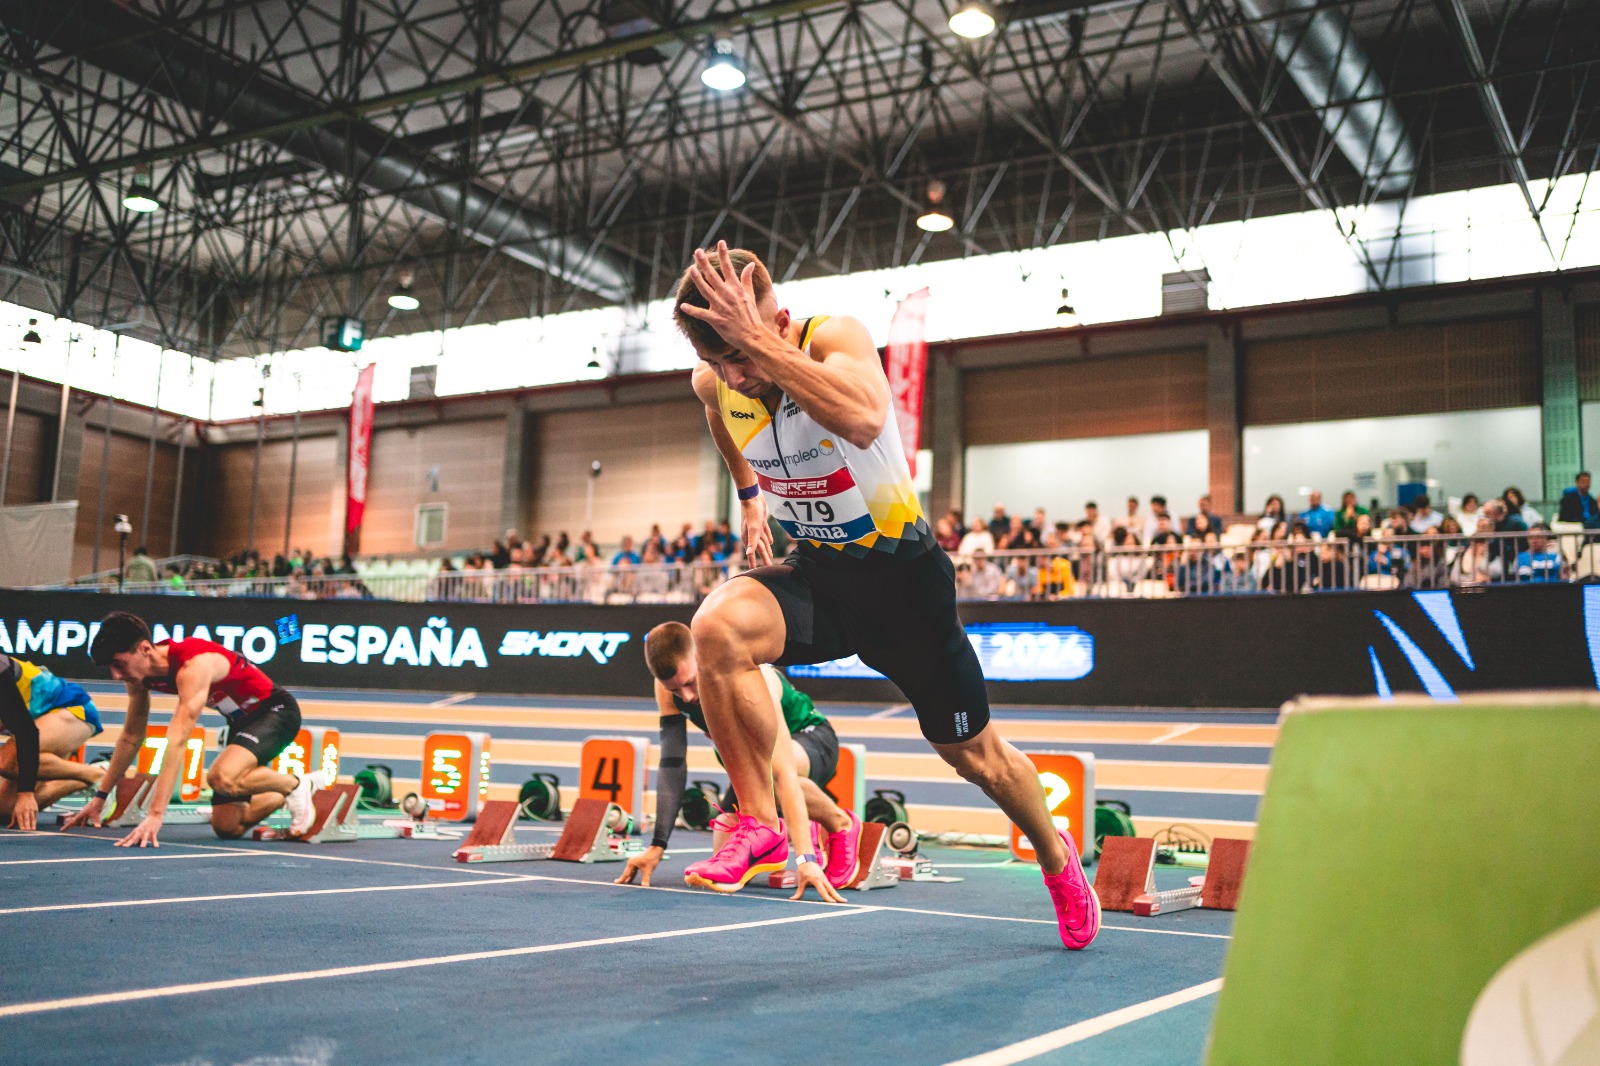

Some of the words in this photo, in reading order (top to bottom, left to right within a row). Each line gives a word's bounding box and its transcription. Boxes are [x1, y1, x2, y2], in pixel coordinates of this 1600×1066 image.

[343, 319, 362, 347] F
[788, 480, 828, 492] RFEA
[782, 500, 835, 523] 179
[795, 523, 848, 540] Joma
[301, 616, 488, 668] ESPAÑA
[499, 631, 630, 665] SHORT
[145, 737, 169, 775] 7
[431, 750, 462, 794] 5
[592, 757, 622, 803] 4
[1037, 771, 1071, 831] 2
